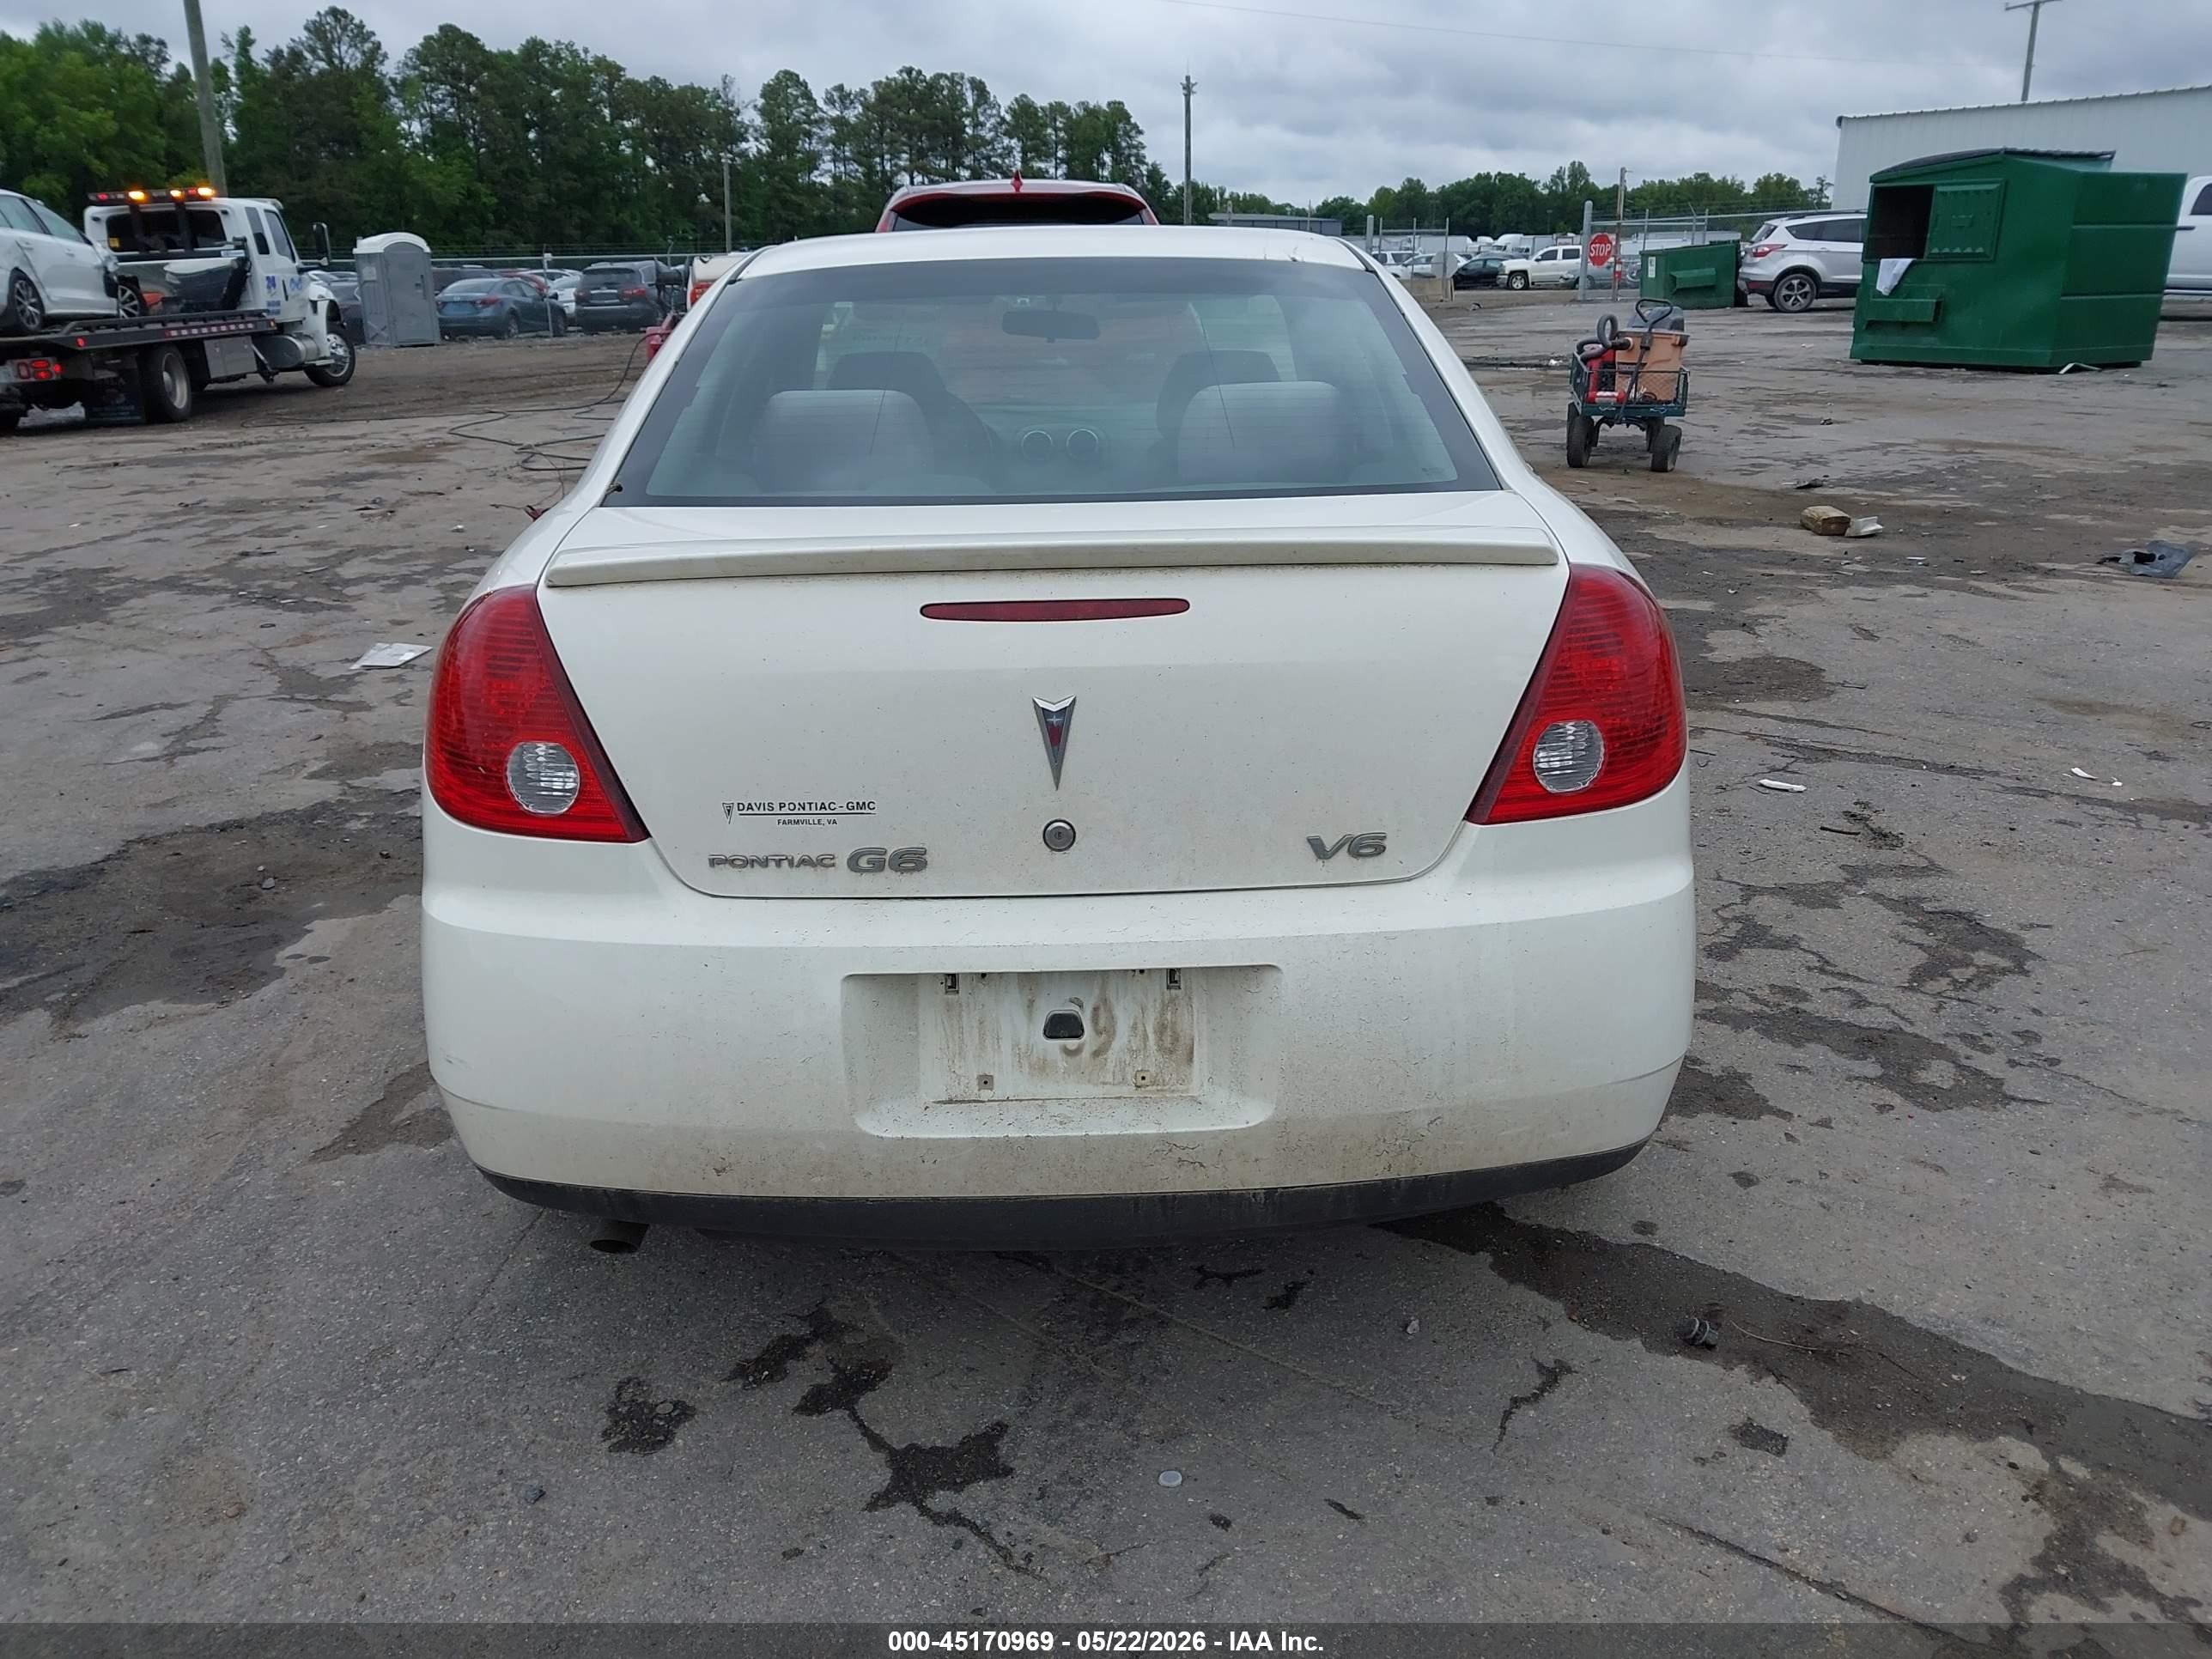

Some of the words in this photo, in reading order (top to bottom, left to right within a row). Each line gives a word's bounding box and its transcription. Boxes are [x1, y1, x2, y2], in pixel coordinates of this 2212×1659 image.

[1589, 243, 1611, 257] STOP
[737, 801, 775, 811] DAVIS
[1306, 832, 1387, 860] V6
[708, 854, 836, 869] PONTIAC
[847, 847, 928, 873] G6
